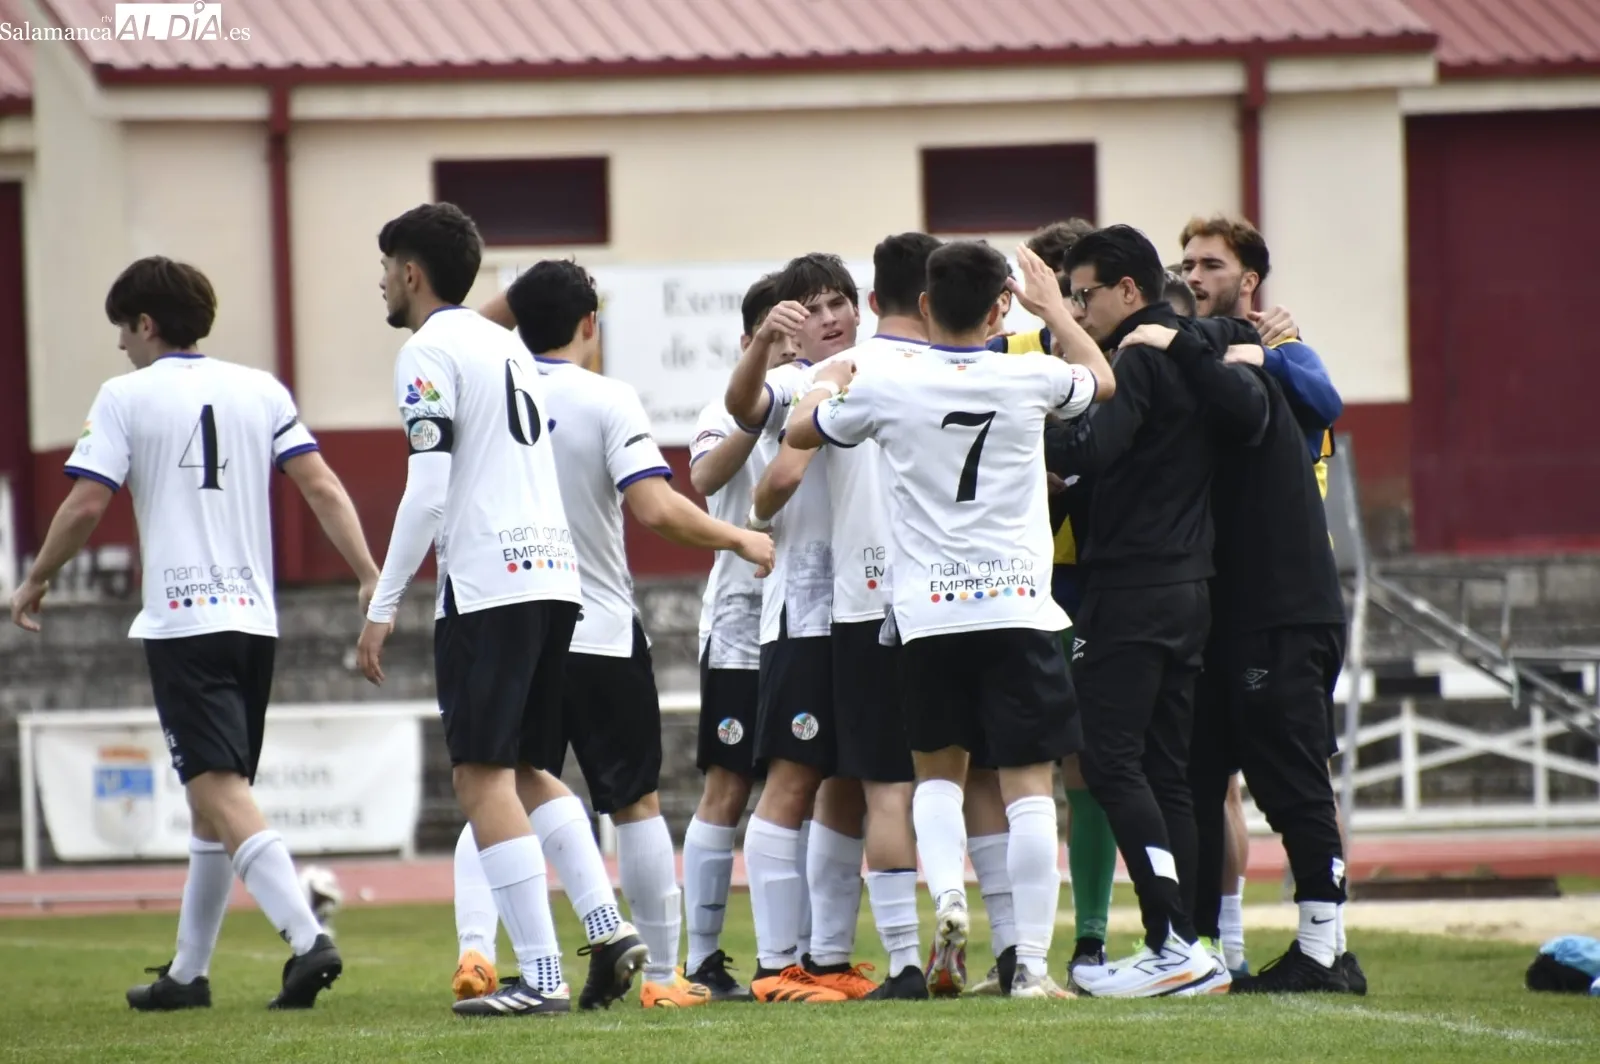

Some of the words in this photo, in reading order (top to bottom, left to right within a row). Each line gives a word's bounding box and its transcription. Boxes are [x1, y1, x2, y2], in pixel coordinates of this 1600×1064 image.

[505, 358, 541, 447] 6
[178, 404, 229, 491] 4
[941, 410, 997, 503] 7
[498, 521, 538, 545] nani
[930, 559, 971, 577] nani
[978, 556, 1034, 578] grupo
[930, 574, 1037, 592] EMPRESARIAL
